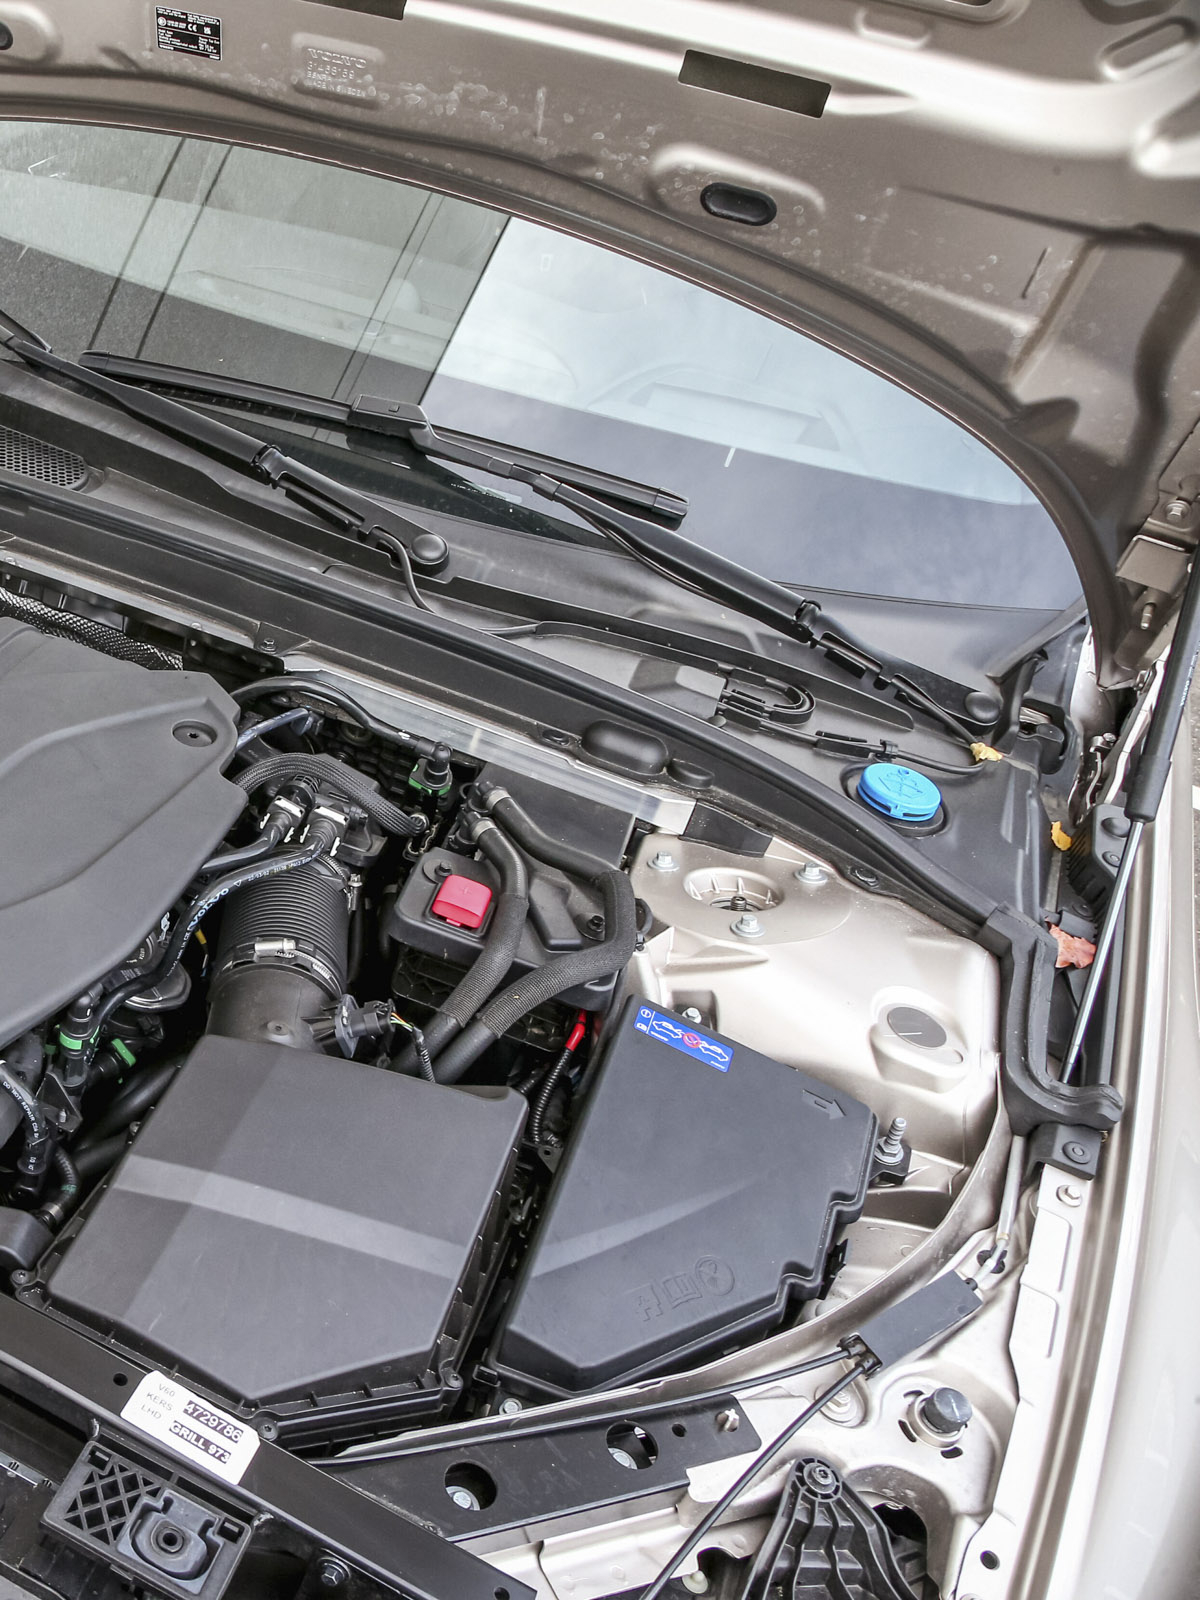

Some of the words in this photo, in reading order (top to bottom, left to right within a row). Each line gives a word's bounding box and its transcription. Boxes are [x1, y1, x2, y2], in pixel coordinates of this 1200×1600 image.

[307, 47, 367, 69] VOLVO
[187, 888, 229, 931] VOLVO
[3, 1081, 11, 1089] DO
[11, 1089, 22, 1100] NOT
[21, 1101, 36, 1122] REPAIR
[146, 1391, 174, 1412] KERS
[158, 1383, 176, 1398] V60
[140, 1404, 163, 1420] LHD
[184, 1402, 243, 1442] 4729786
[170, 1422, 206, 1450] GRILL
[208, 1444, 231, 1462] 973
